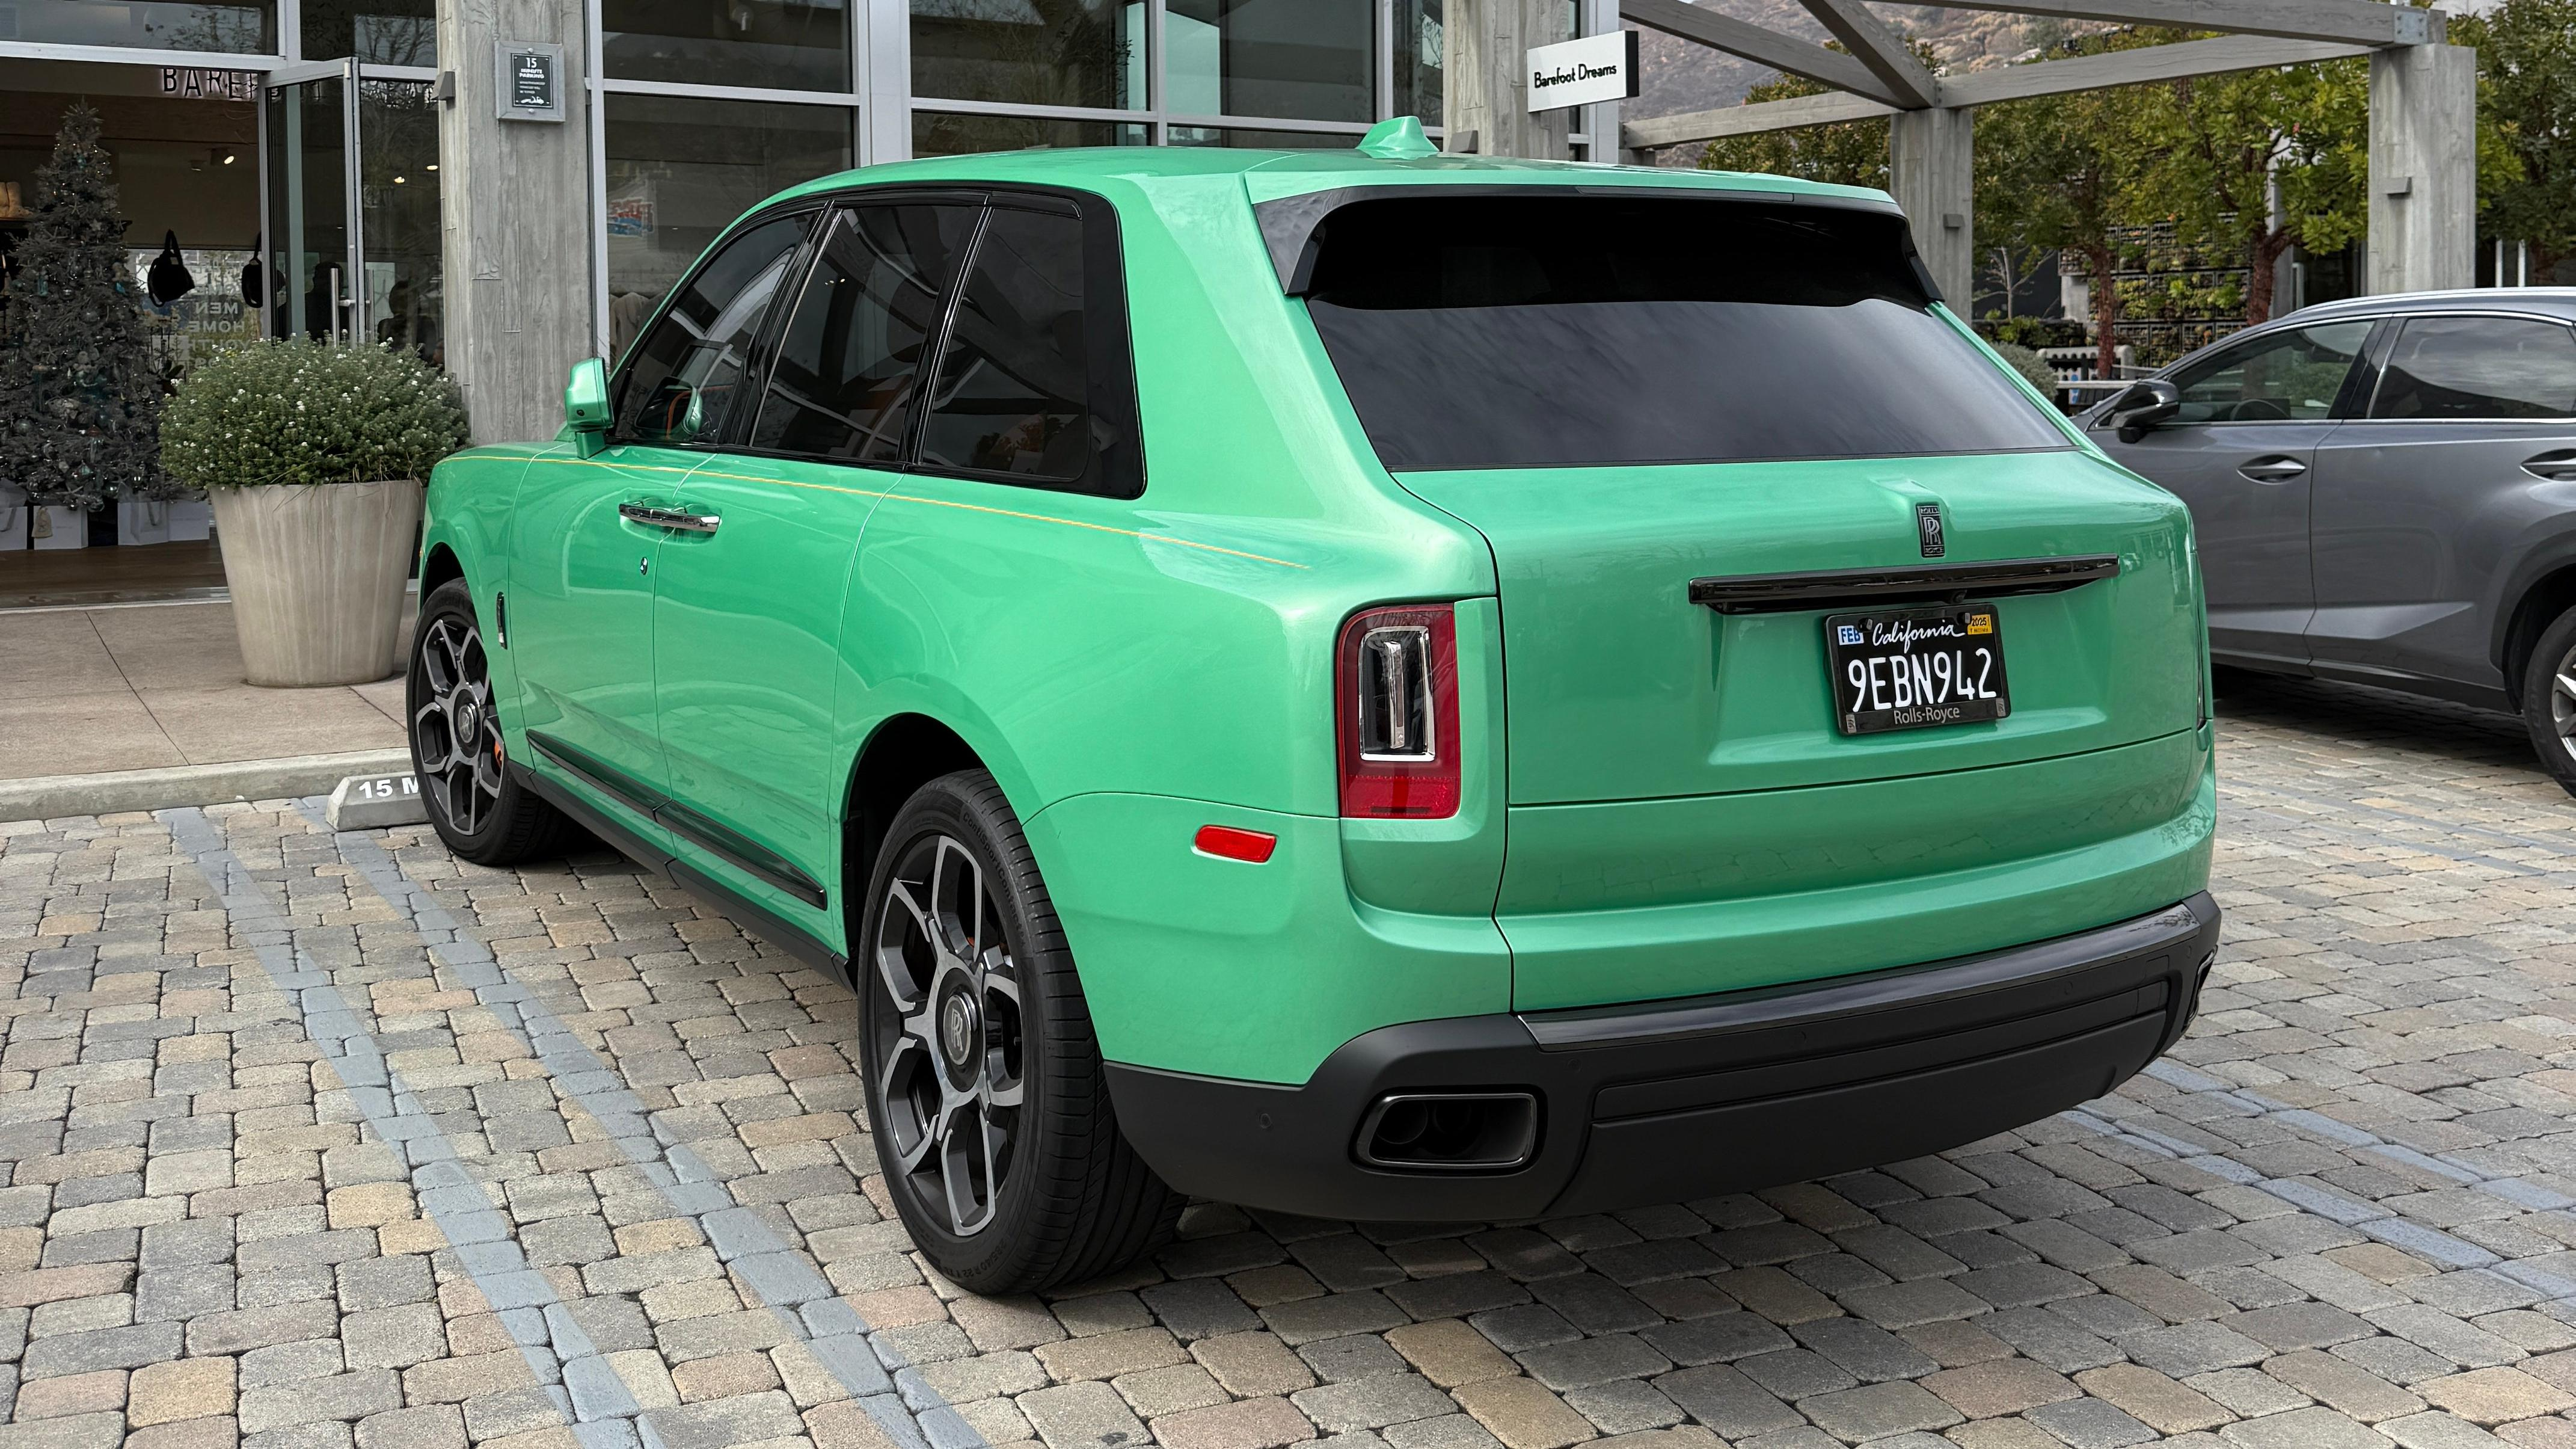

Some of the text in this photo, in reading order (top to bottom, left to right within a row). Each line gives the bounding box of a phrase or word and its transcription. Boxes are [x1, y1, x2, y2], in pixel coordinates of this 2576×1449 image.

[526, 57, 537, 68] 15
[1534, 63, 1617, 88] Barefoot Dreams
[1972, 617, 1987, 627] 2025
[1841, 625, 1860, 643] FEB
[1872, 620, 1966, 654] California
[1848, 647, 1997, 712] 9EBN942
[1894, 706, 1960, 725] Rolls-Royce
[359, 779, 393, 799] 15
